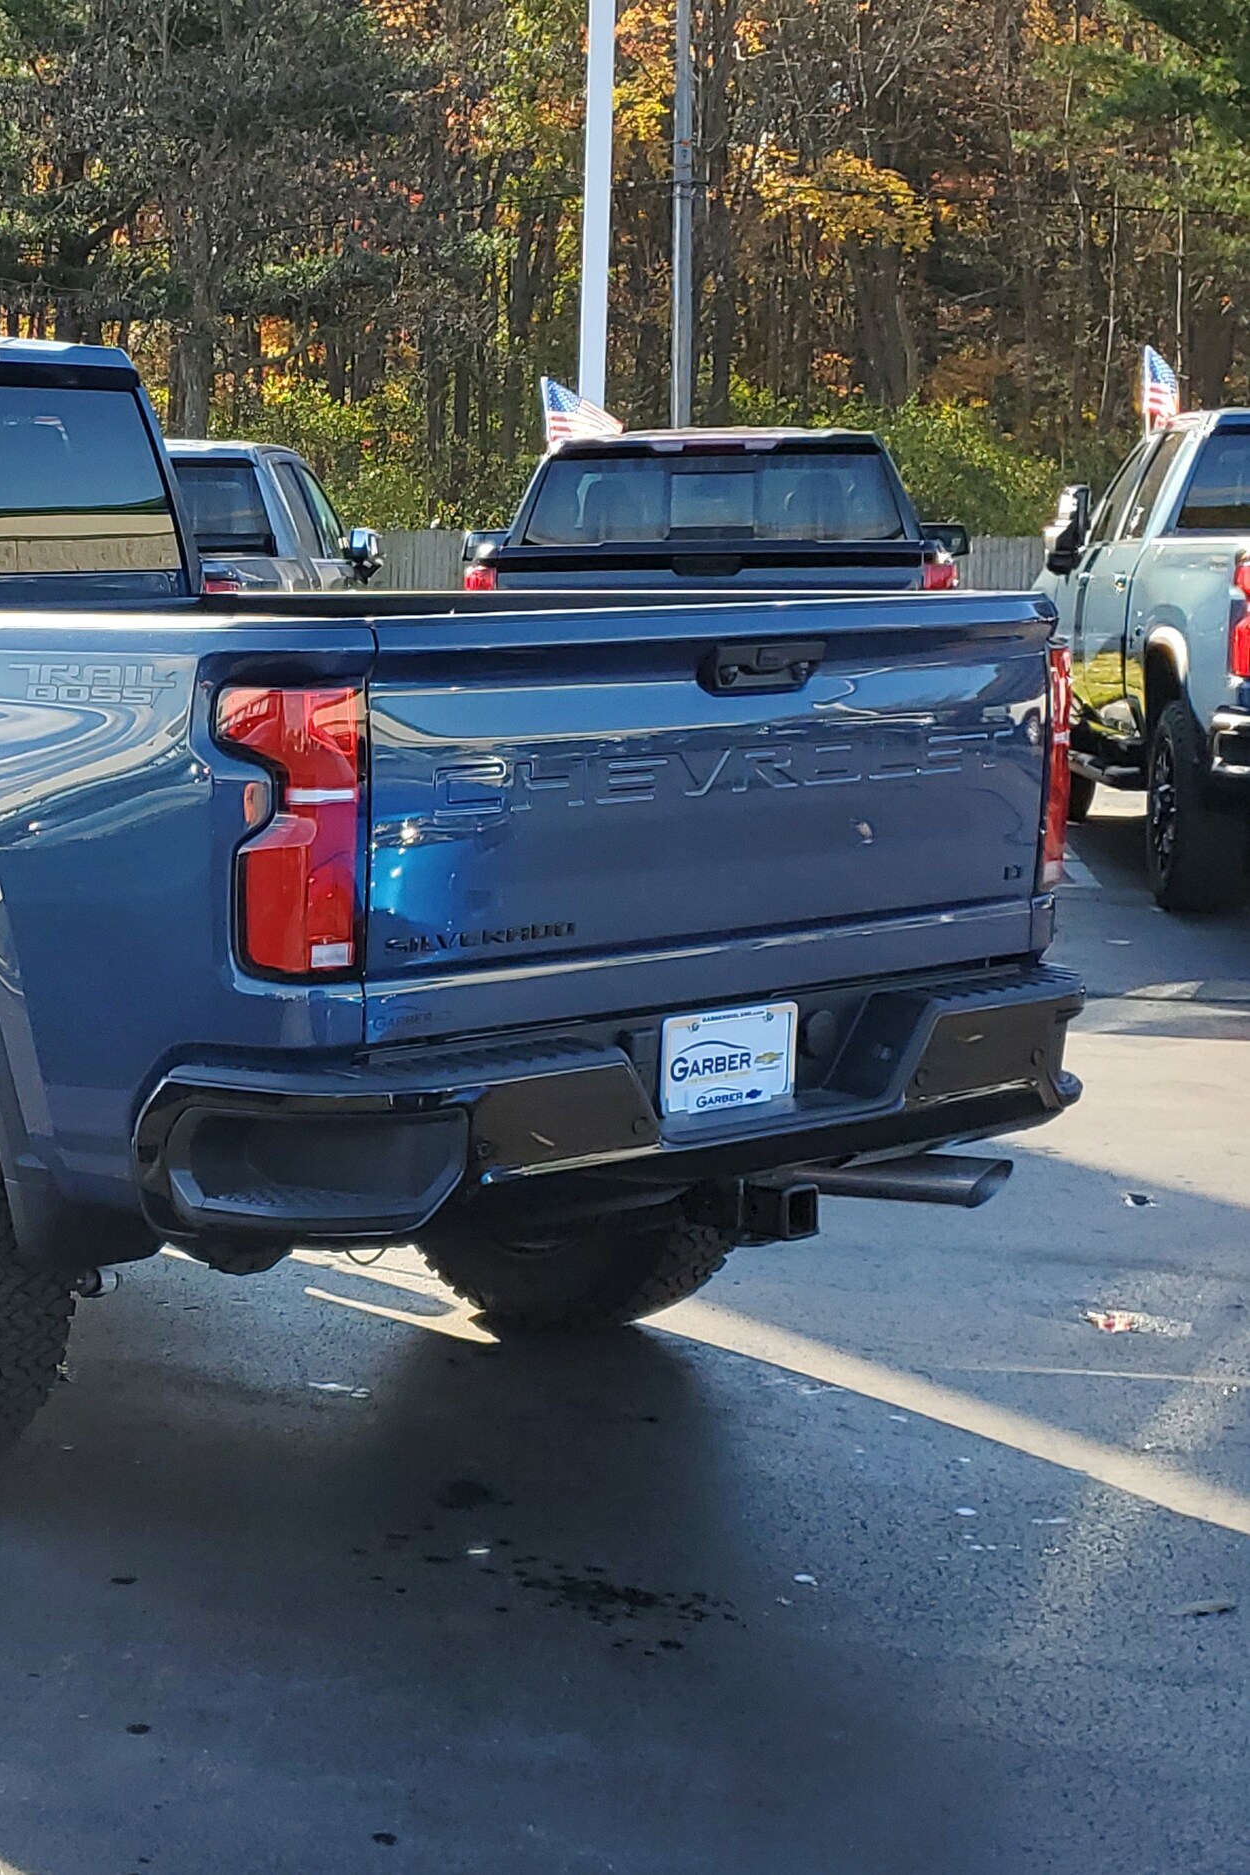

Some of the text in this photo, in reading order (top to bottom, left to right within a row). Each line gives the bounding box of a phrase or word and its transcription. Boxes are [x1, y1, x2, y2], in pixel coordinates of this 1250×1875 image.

[8, 663, 177, 688] TRAIL
[25, 683, 153, 706] BOSS
[433, 719, 1015, 818] CHEVROLET
[384, 921, 577, 954] SILVERADO
[670, 1051, 752, 1082] GARBER
[696, 1091, 744, 1108] GARBER
